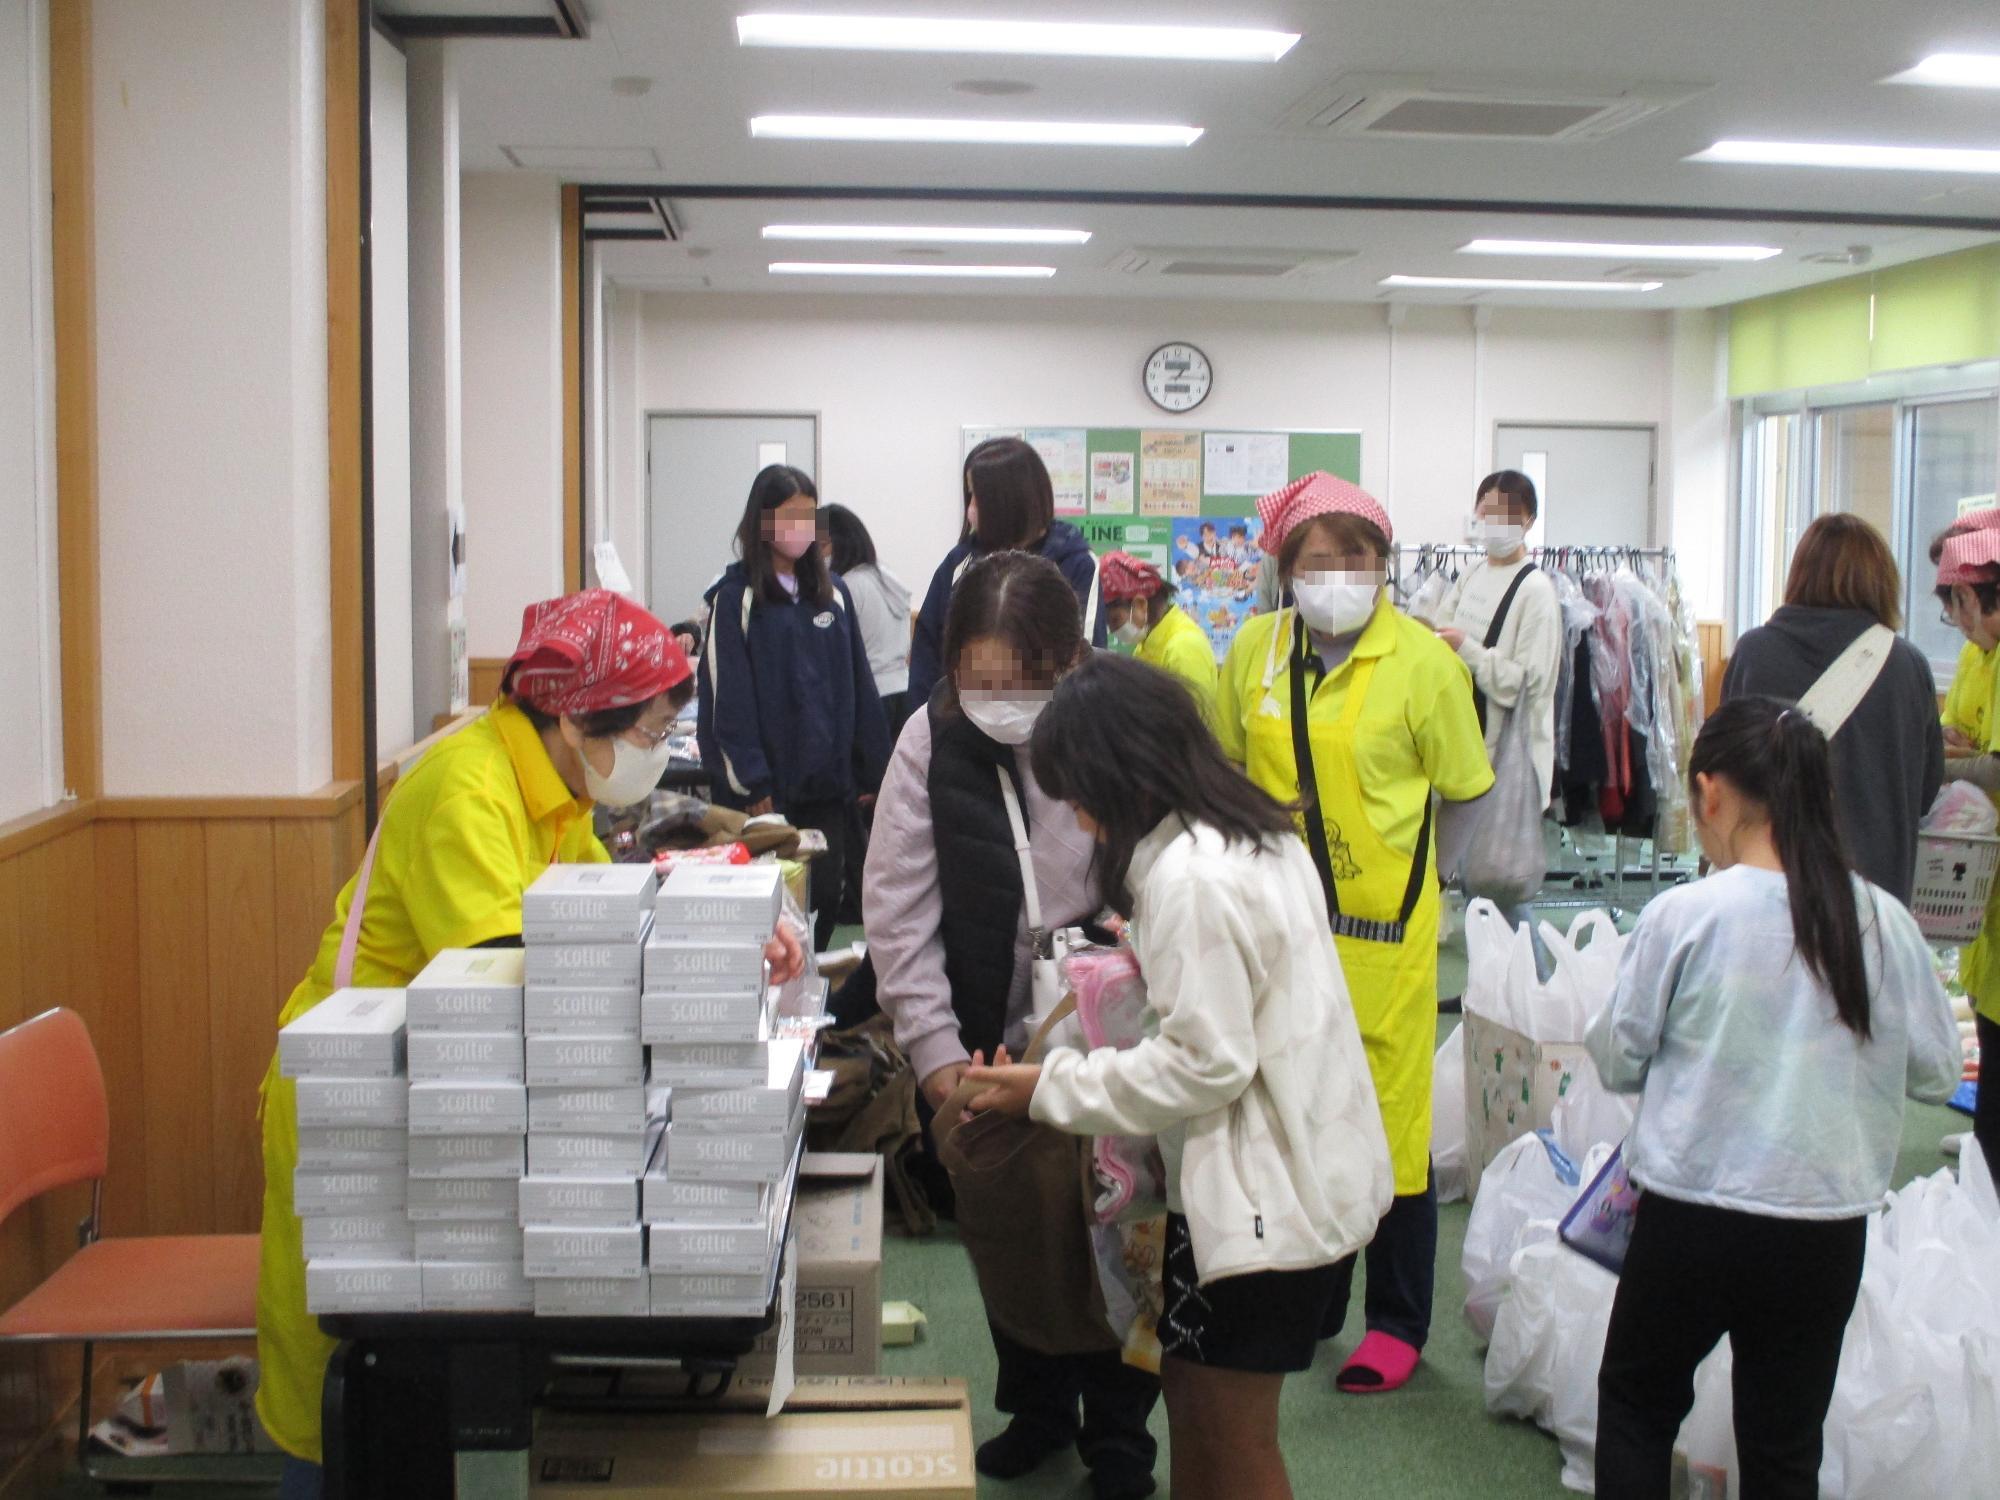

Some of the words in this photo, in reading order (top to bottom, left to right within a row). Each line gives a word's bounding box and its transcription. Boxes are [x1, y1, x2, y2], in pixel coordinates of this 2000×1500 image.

[551, 898, 607, 918] scottie
[684, 901, 741, 921] scottie
[554, 949, 611, 968] scottie
[673, 952, 731, 970] scottie
[436, 992, 492, 1013] scottie
[553, 997, 610, 1015] scottie
[671, 1001, 728, 1021] scottie
[308, 1039, 364, 1059] scottie
[436, 1041, 493, 1061] scottie
[556, 1045, 612, 1064] scottie
[325, 1085, 381, 1106] scottie
[439, 1092, 495, 1112] scottie
[558, 1093, 614, 1111] scottie
[701, 1094, 757, 1113] scottie
[558, 1139, 613, 1157] scottie
[697, 1140, 752, 1159] scottie
[323, 1174, 378, 1193] scottie
[548, 1189, 604, 1208] scottie
[673, 1185, 728, 1203] scottie
[329, 1218, 385, 1239] scottie
[444, 1225, 500, 1244] scottie
[554, 1237, 610, 1256] scottie
[680, 1234, 736, 1253] scottie
[335, 1271, 392, 1293] scottie
[451, 1270, 507, 1290] scottie
[815, 1453, 957, 1479] scottie
